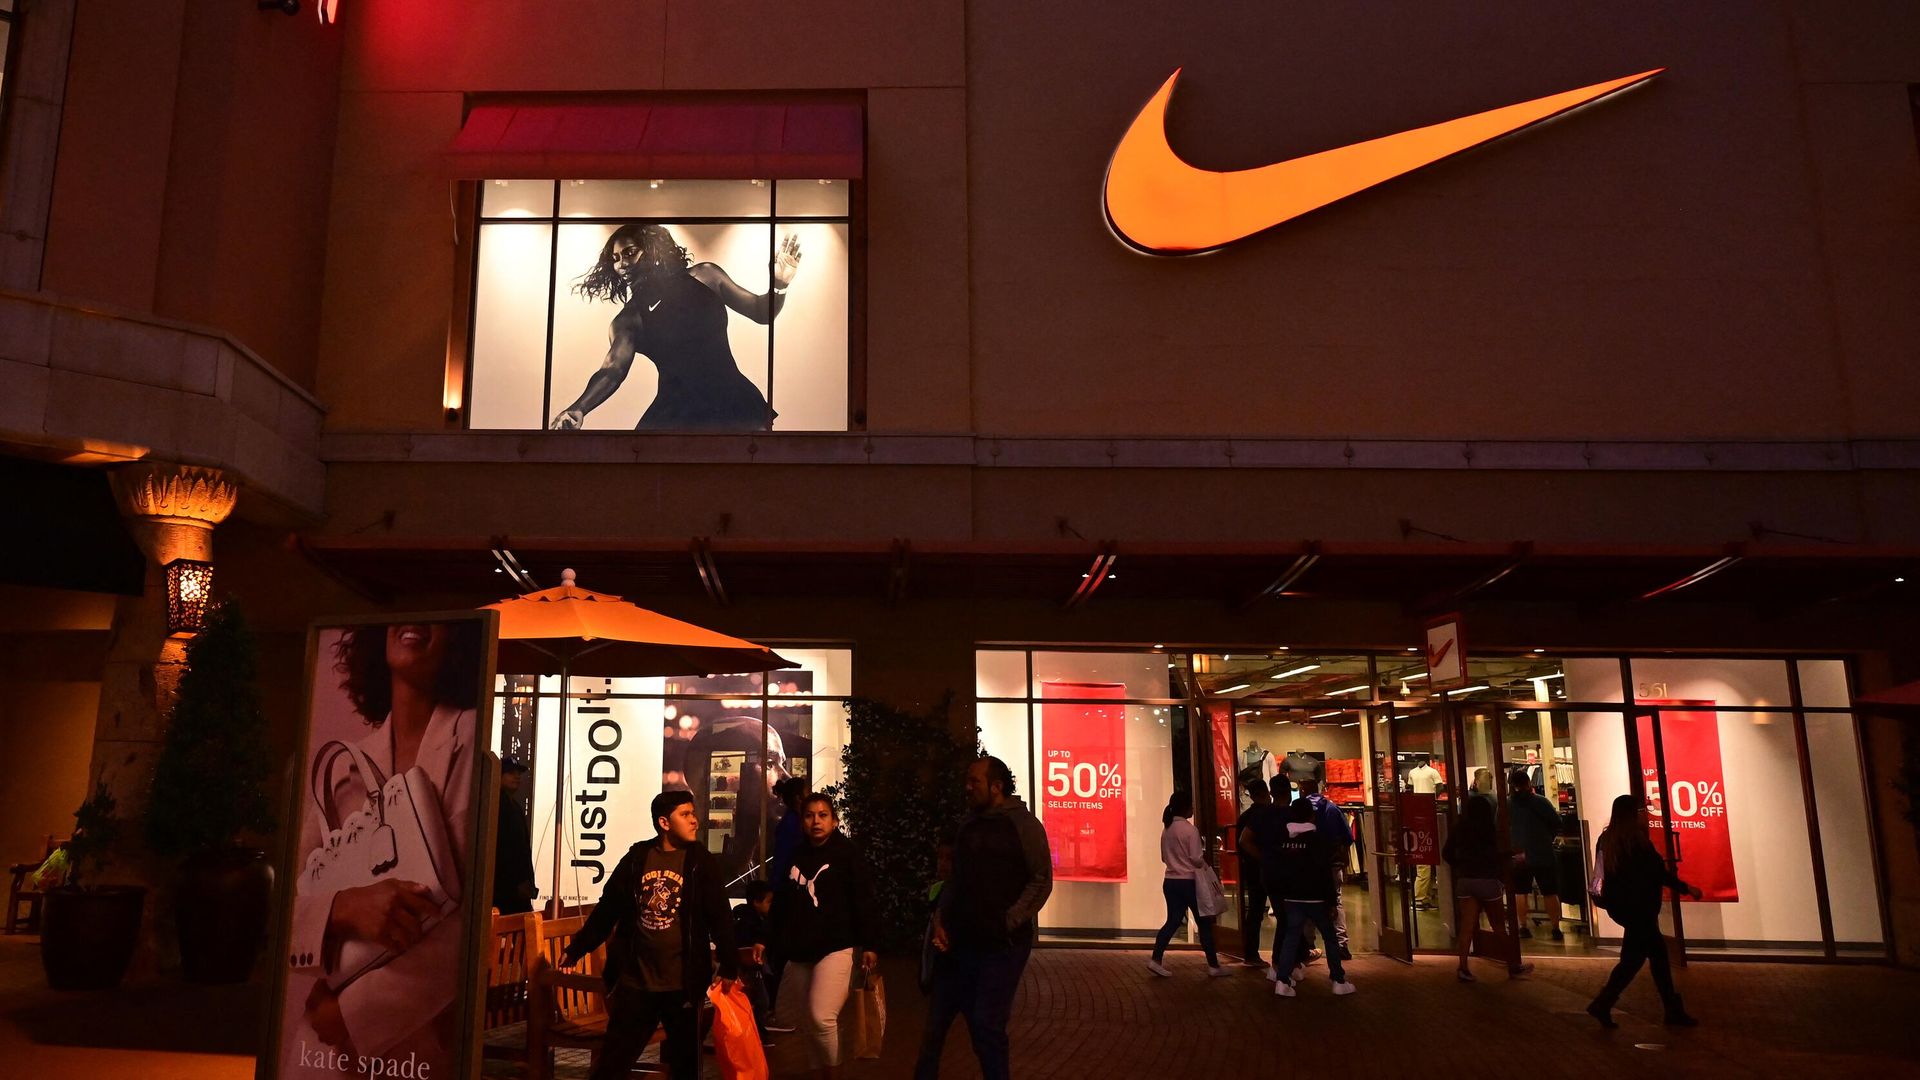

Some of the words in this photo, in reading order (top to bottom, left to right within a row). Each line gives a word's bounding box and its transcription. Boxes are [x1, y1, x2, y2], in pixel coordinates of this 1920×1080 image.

[1047, 762, 1121, 798] 50%
[1099, 788, 1121, 798] OFF
[1645, 780, 1723, 818] 50%
[1048, 801, 1077, 809] SELECT
[1079, 802, 1103, 810] ITEMS
[1700, 806, 1724, 818] OFF
[1648, 820, 1679, 829] SELCT
[1681, 821, 1706, 829] ITEMS
[571, 790, 607, 884] Just
[1419, 845, 1433, 853] OFF
[299, 1040, 349, 1072] kate
[357, 1052, 430, 1080] spade
